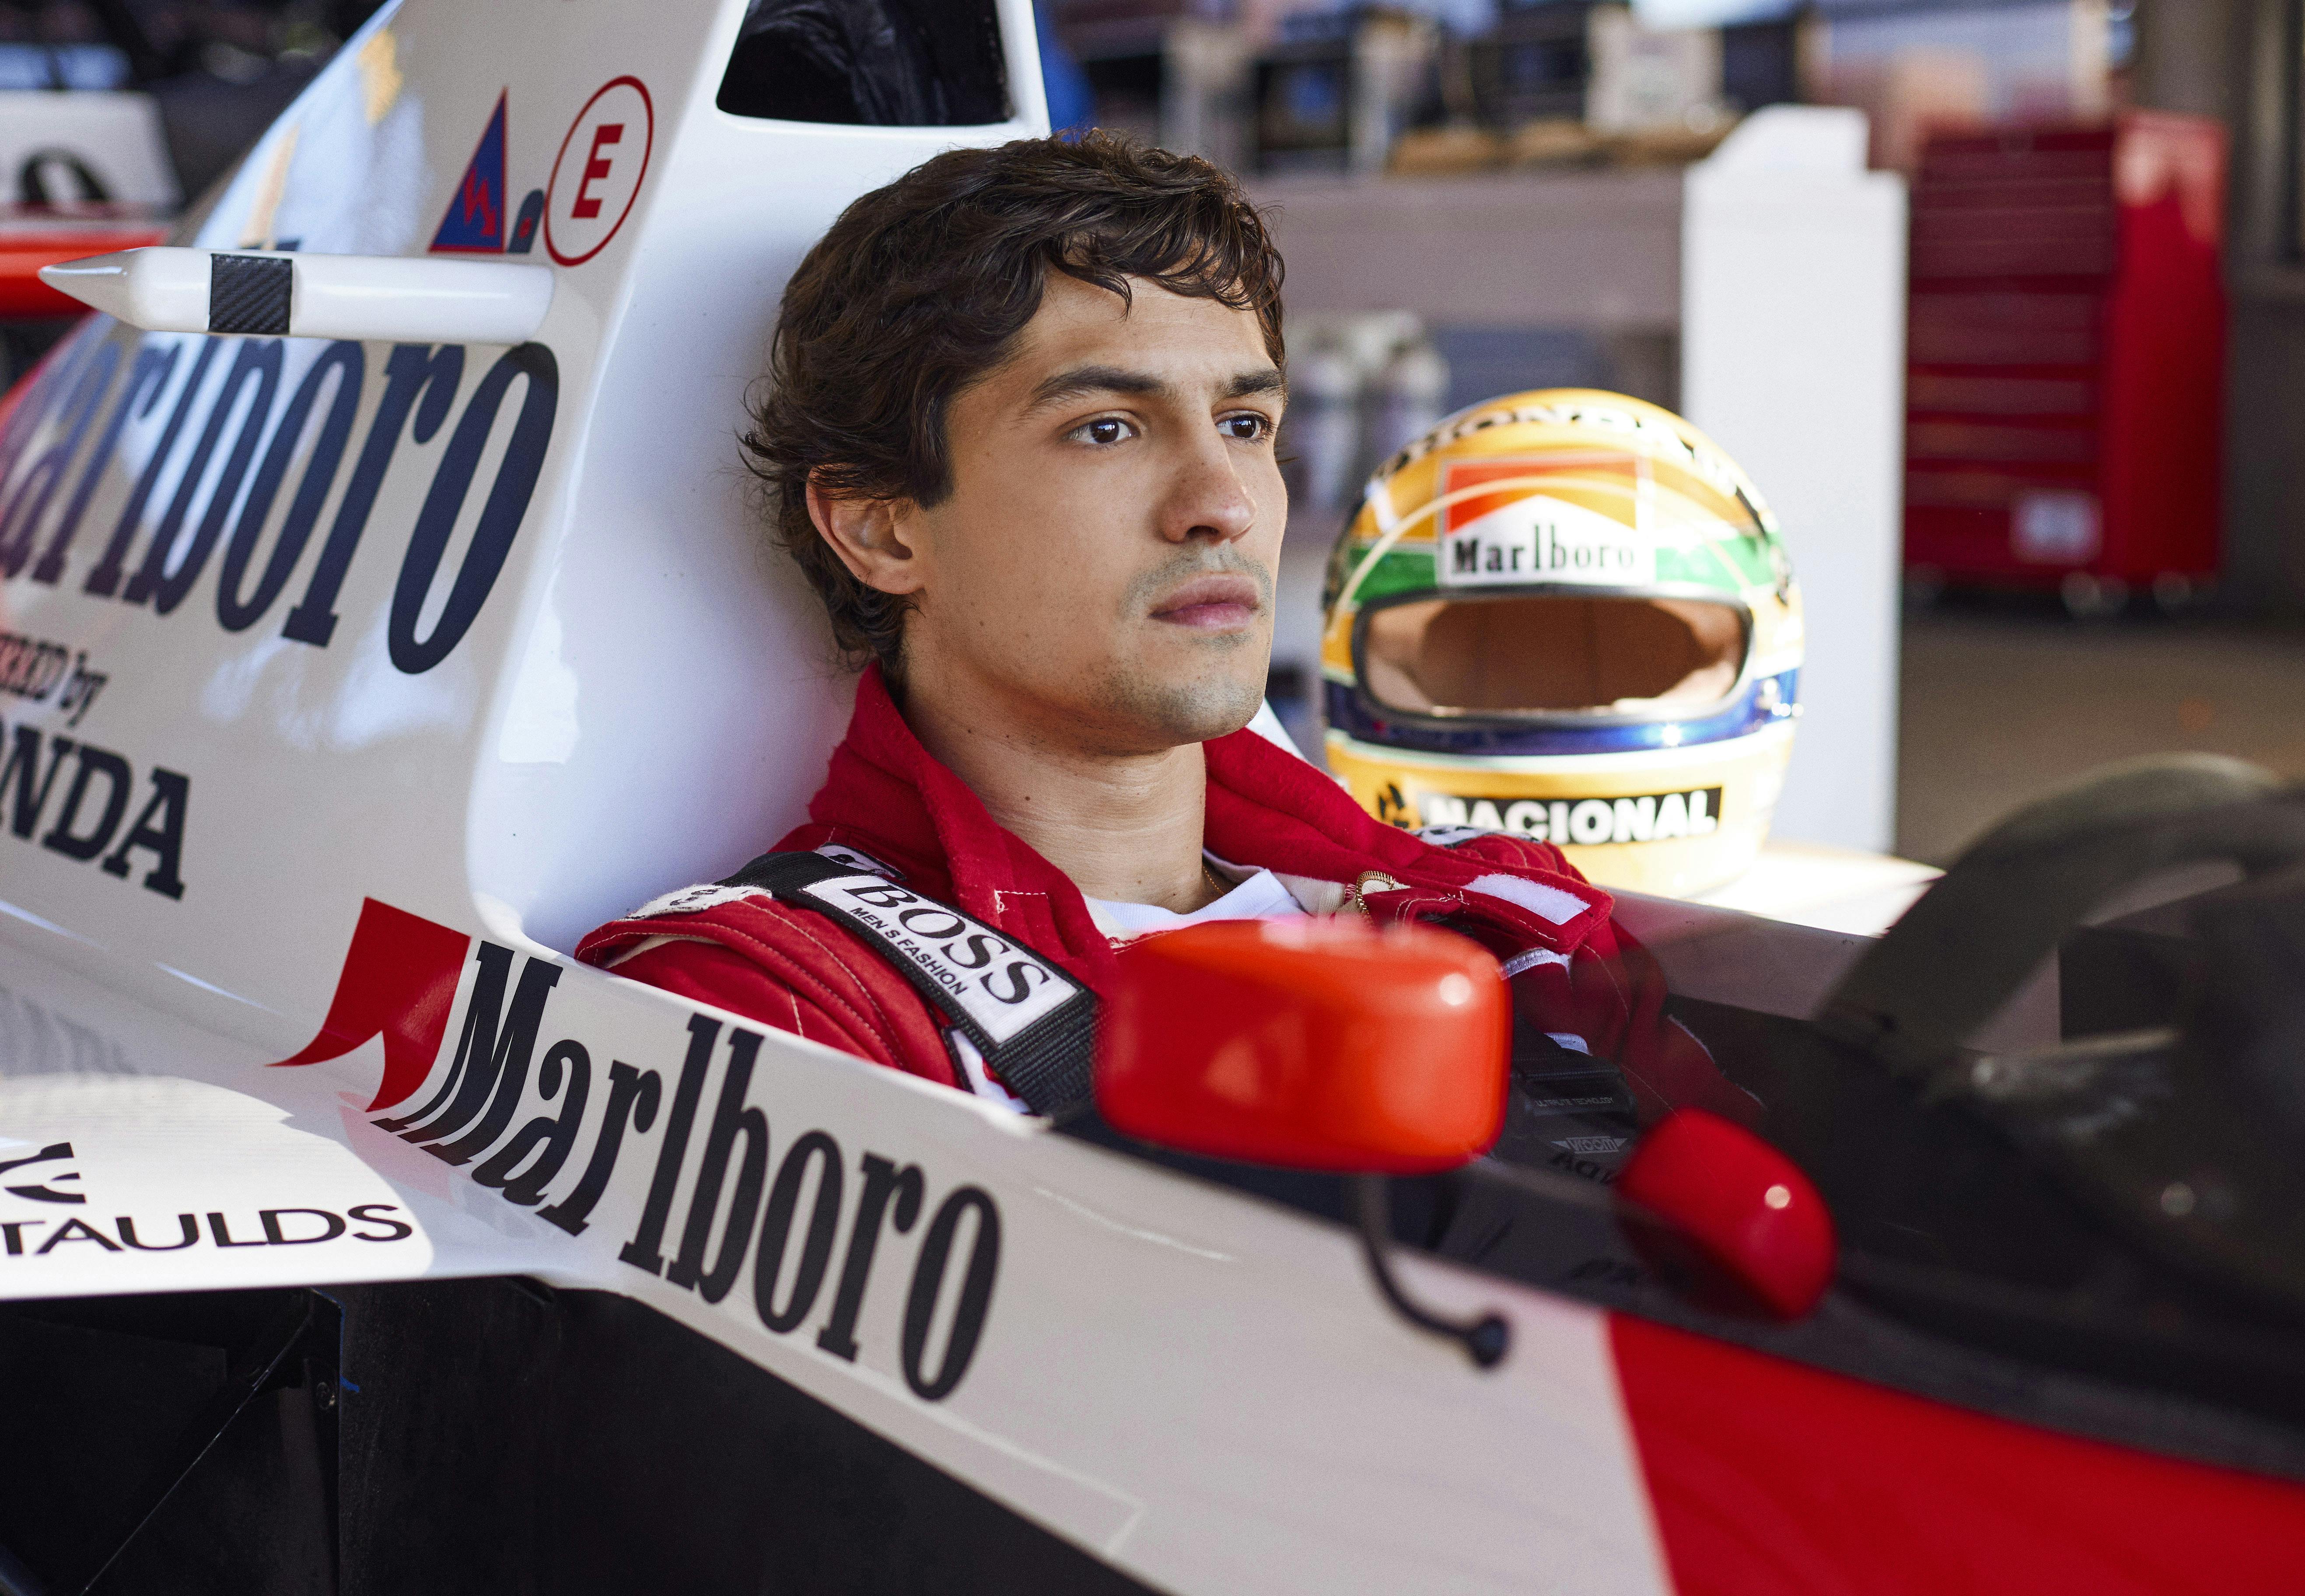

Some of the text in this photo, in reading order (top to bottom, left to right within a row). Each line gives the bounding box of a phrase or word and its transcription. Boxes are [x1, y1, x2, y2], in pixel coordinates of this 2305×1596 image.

[571, 123, 625, 219] E
[0, 306, 559, 675] arlboro
[1452, 523, 1635, 575] Marlboro
[0, 711, 192, 901] NDA
[1425, 790, 1718, 844] NACIONAL
[843, 884, 1051, 1004] BOSS
[897, 938, 968, 996] FASHION
[370, 940, 1001, 1402] Marlboro
